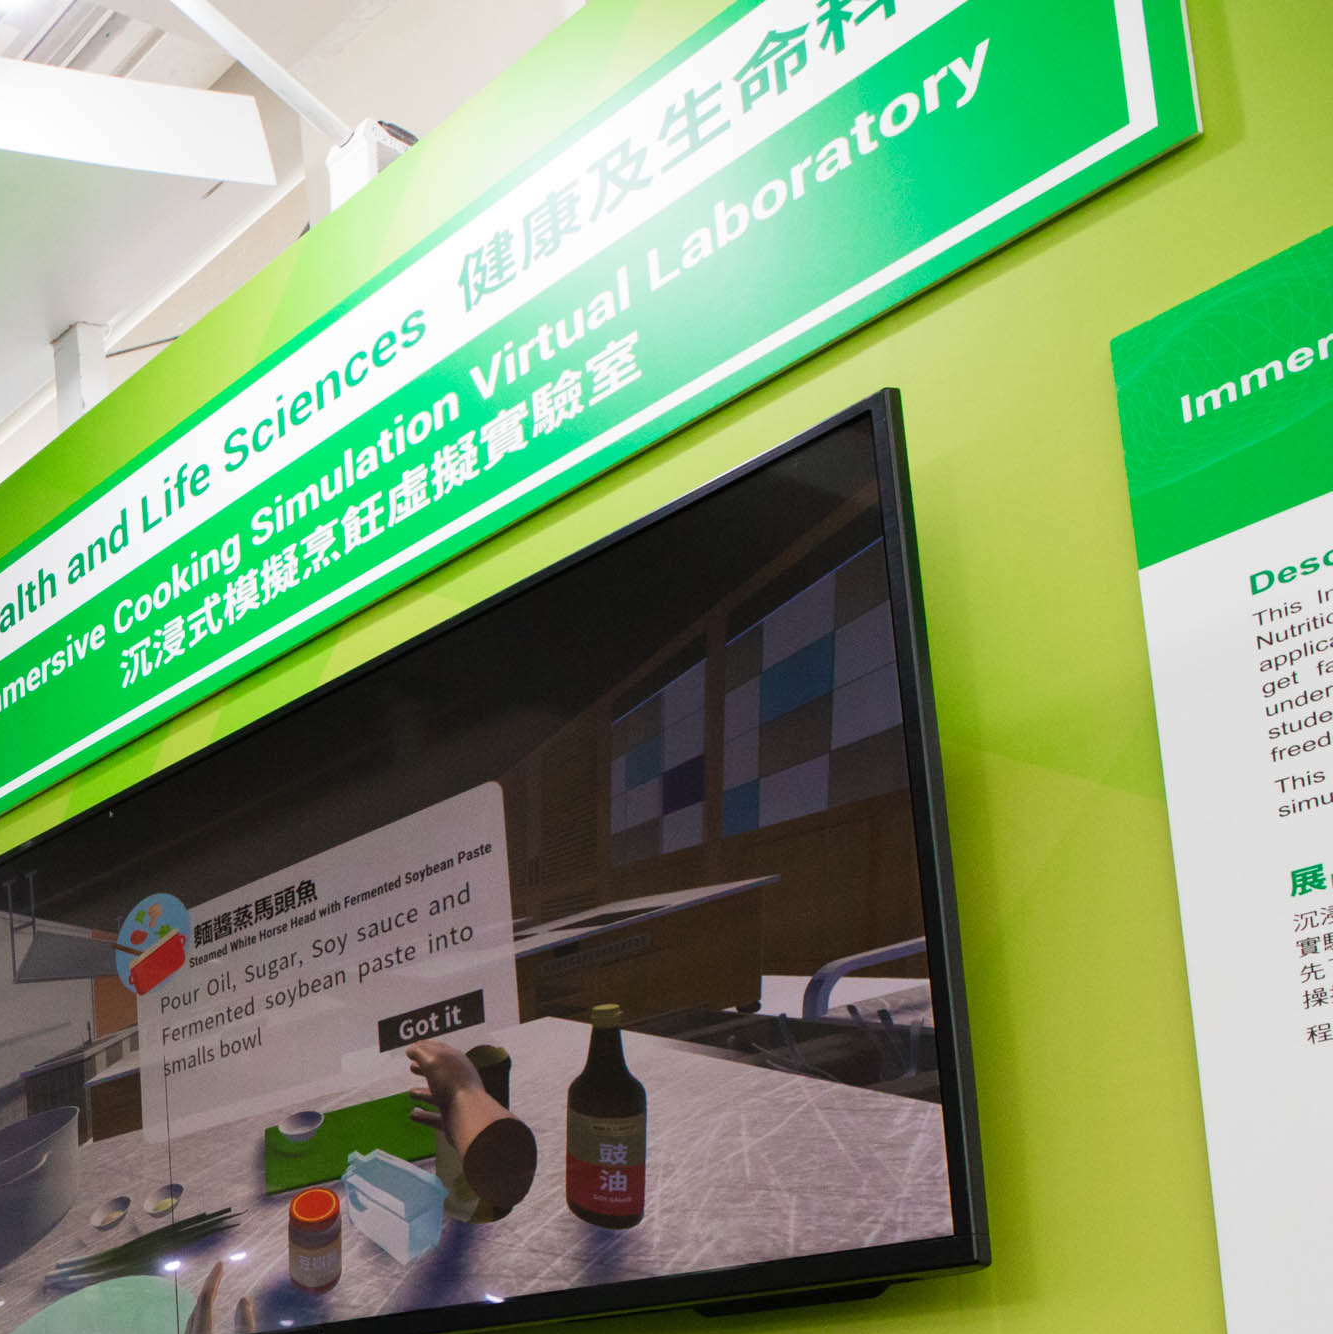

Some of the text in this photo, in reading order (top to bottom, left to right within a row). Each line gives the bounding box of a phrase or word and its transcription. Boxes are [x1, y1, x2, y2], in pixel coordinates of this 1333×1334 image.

[113, 531, 241, 634] Cooking
[251, 391, 459, 546] Simulation
[470, 266, 630, 401] Virtual
[647, 38, 990, 292] Laboratory
[68, 509, 128, 584] and
[141, 463, 211, 534] Life
[224, 310, 425, 472] Sciences
[119, 330, 642, 689] 沉浸式模擬烹飪虛擬實驗室
[1252, 601, 1302, 626] This
[1259, 636, 1333, 672] applic
[1262, 670, 1299, 698] get
[1268, 711, 1333, 740] stude
[1274, 770, 1326, 793] This
[1290, 863, 1333, 897] 展
[189, 842, 493, 968] Steamed White Horse Head with Fermented Soybean Paste
[160, 883, 472, 1014] Pour Oil, Sugar, Soy sauce and
[161, 924, 474, 1046] Fermented soybean paste into
[1300, 958, 1333, 984] 先
[1302, 984, 1333, 1010] 操
[398, 1003, 463, 1041] Got it
[1306, 1022, 1333, 1045] 程
[163, 1027, 263, 1078] smalls bowl
[598, 1143, 629, 1193] 豉油
